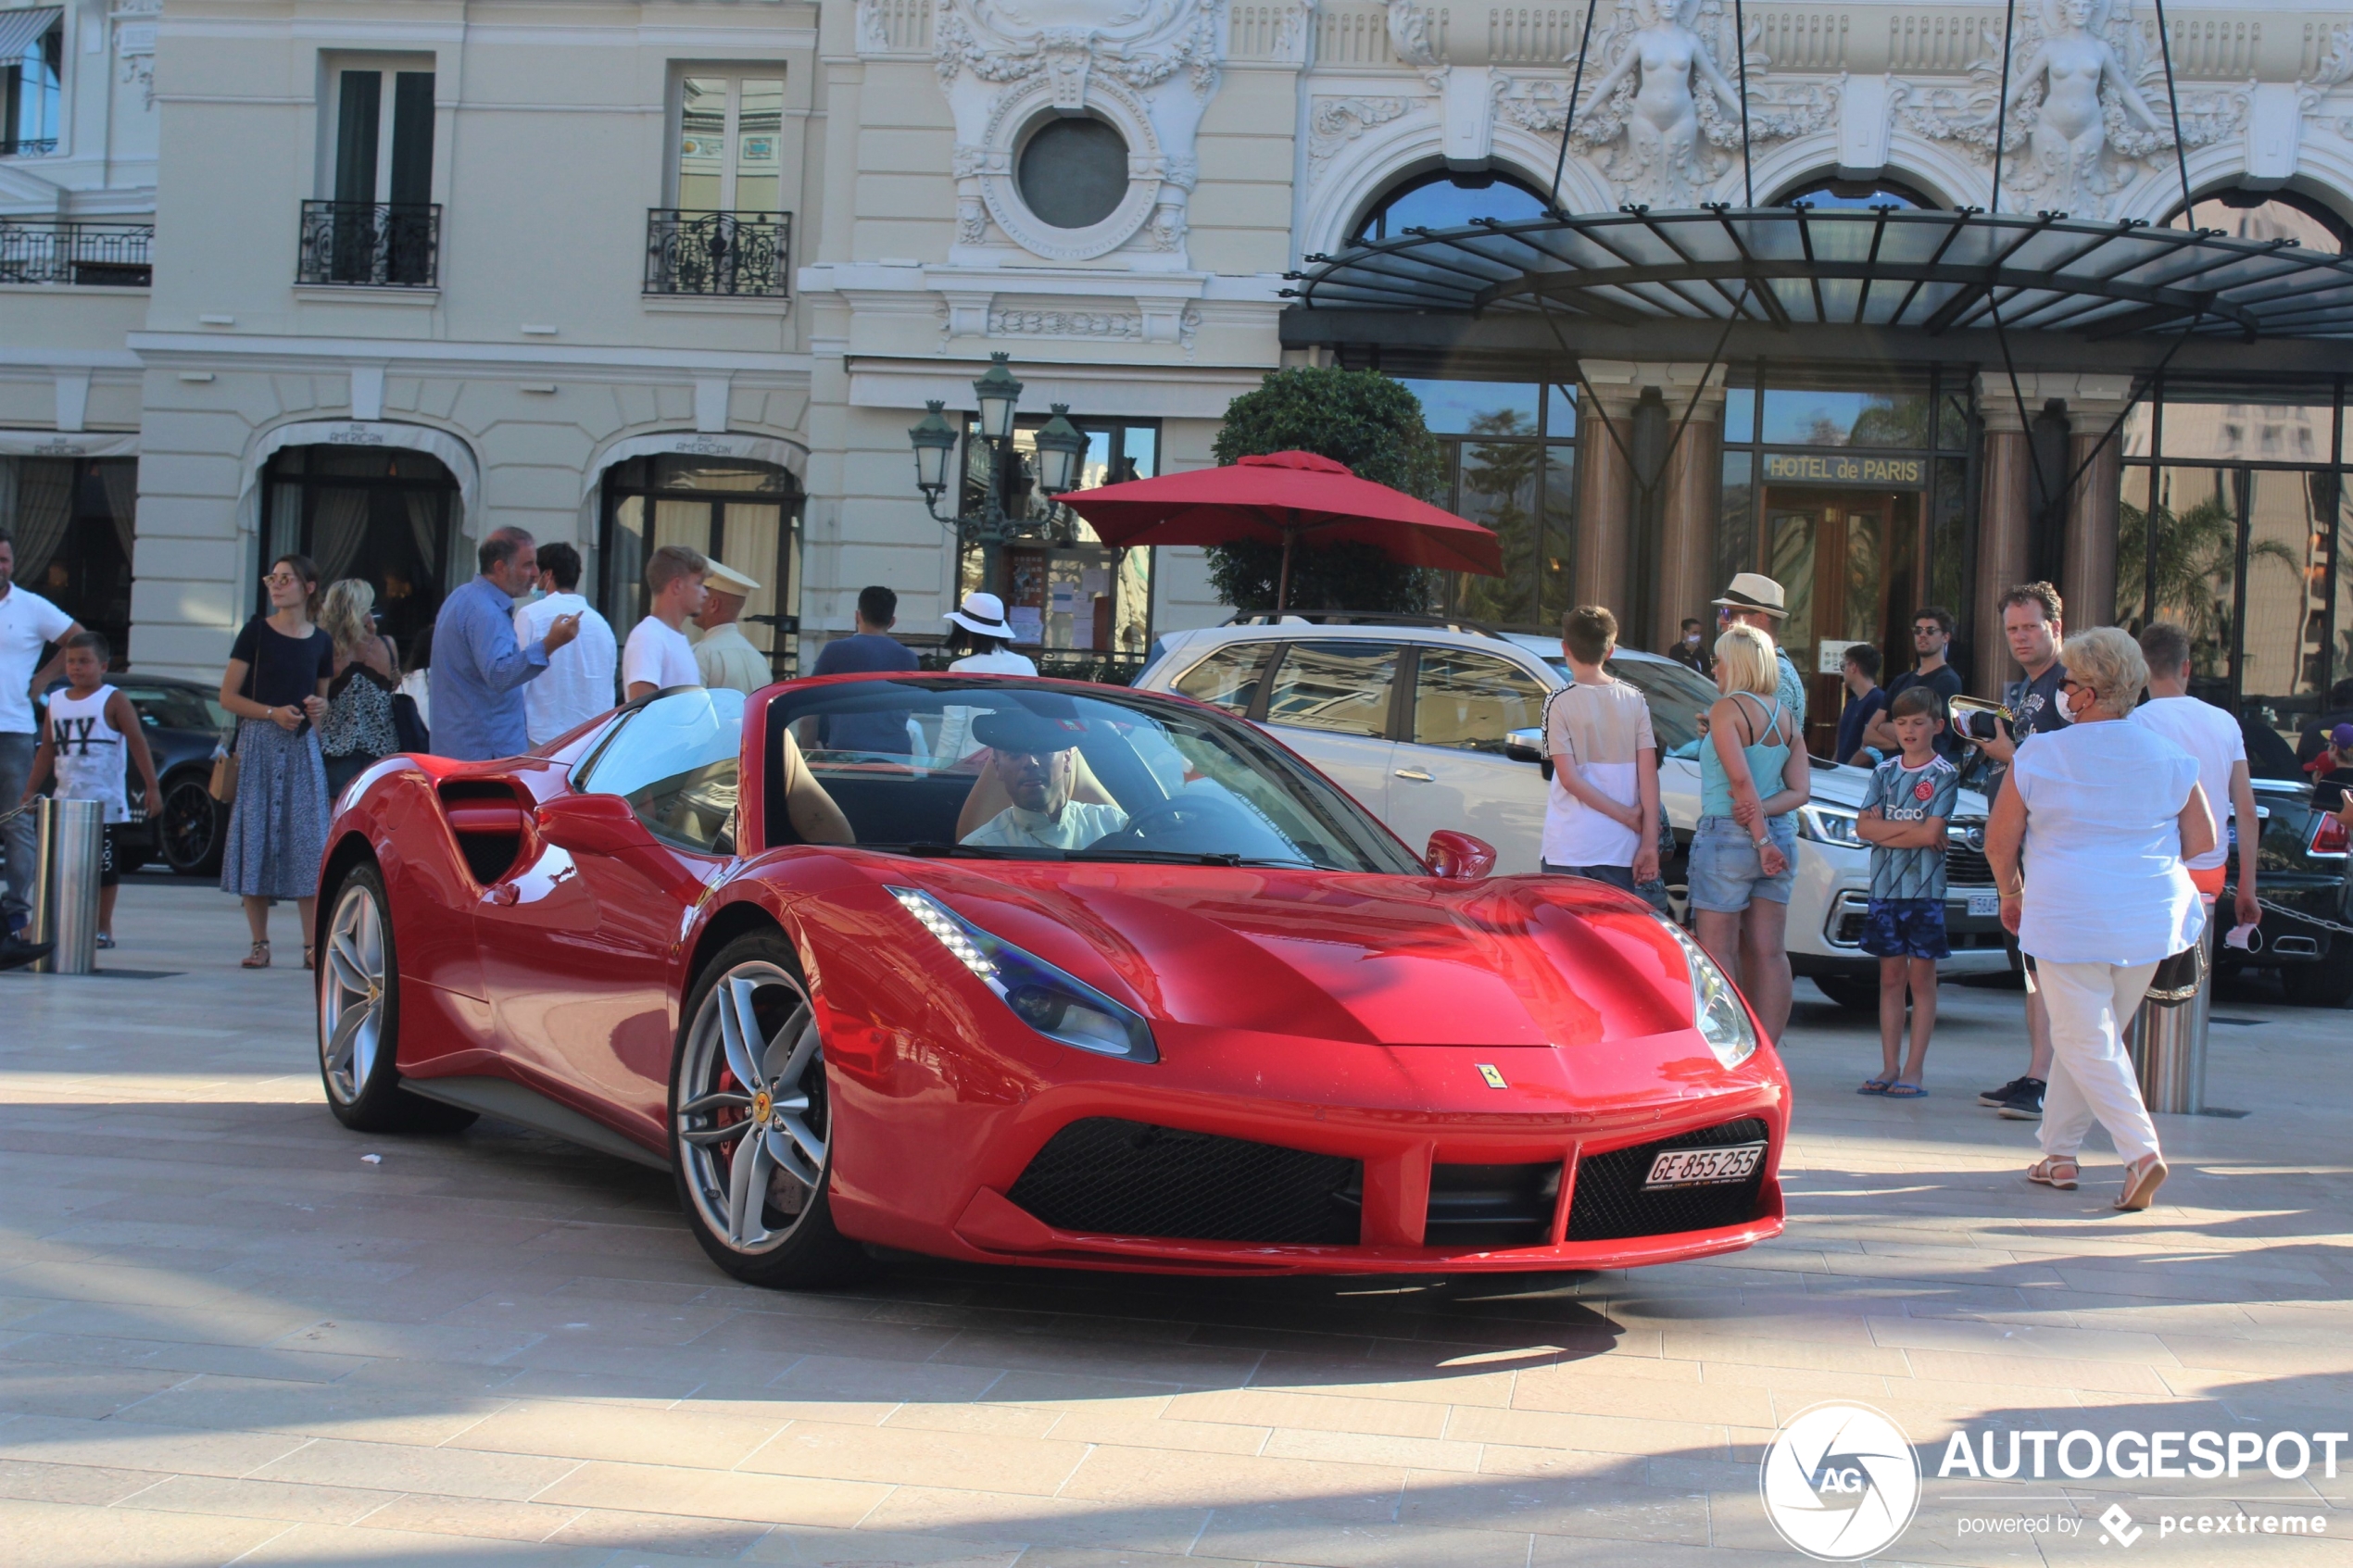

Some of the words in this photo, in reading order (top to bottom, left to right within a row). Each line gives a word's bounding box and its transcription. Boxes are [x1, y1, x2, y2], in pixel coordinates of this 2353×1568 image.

[1769, 457, 1832, 479] HOTEL
[1837, 458, 1858, 480] de
[1863, 459, 1919, 483] PARIS
[54, 717, 96, 756] NY
[1717, 1149, 1758, 1176] 255
